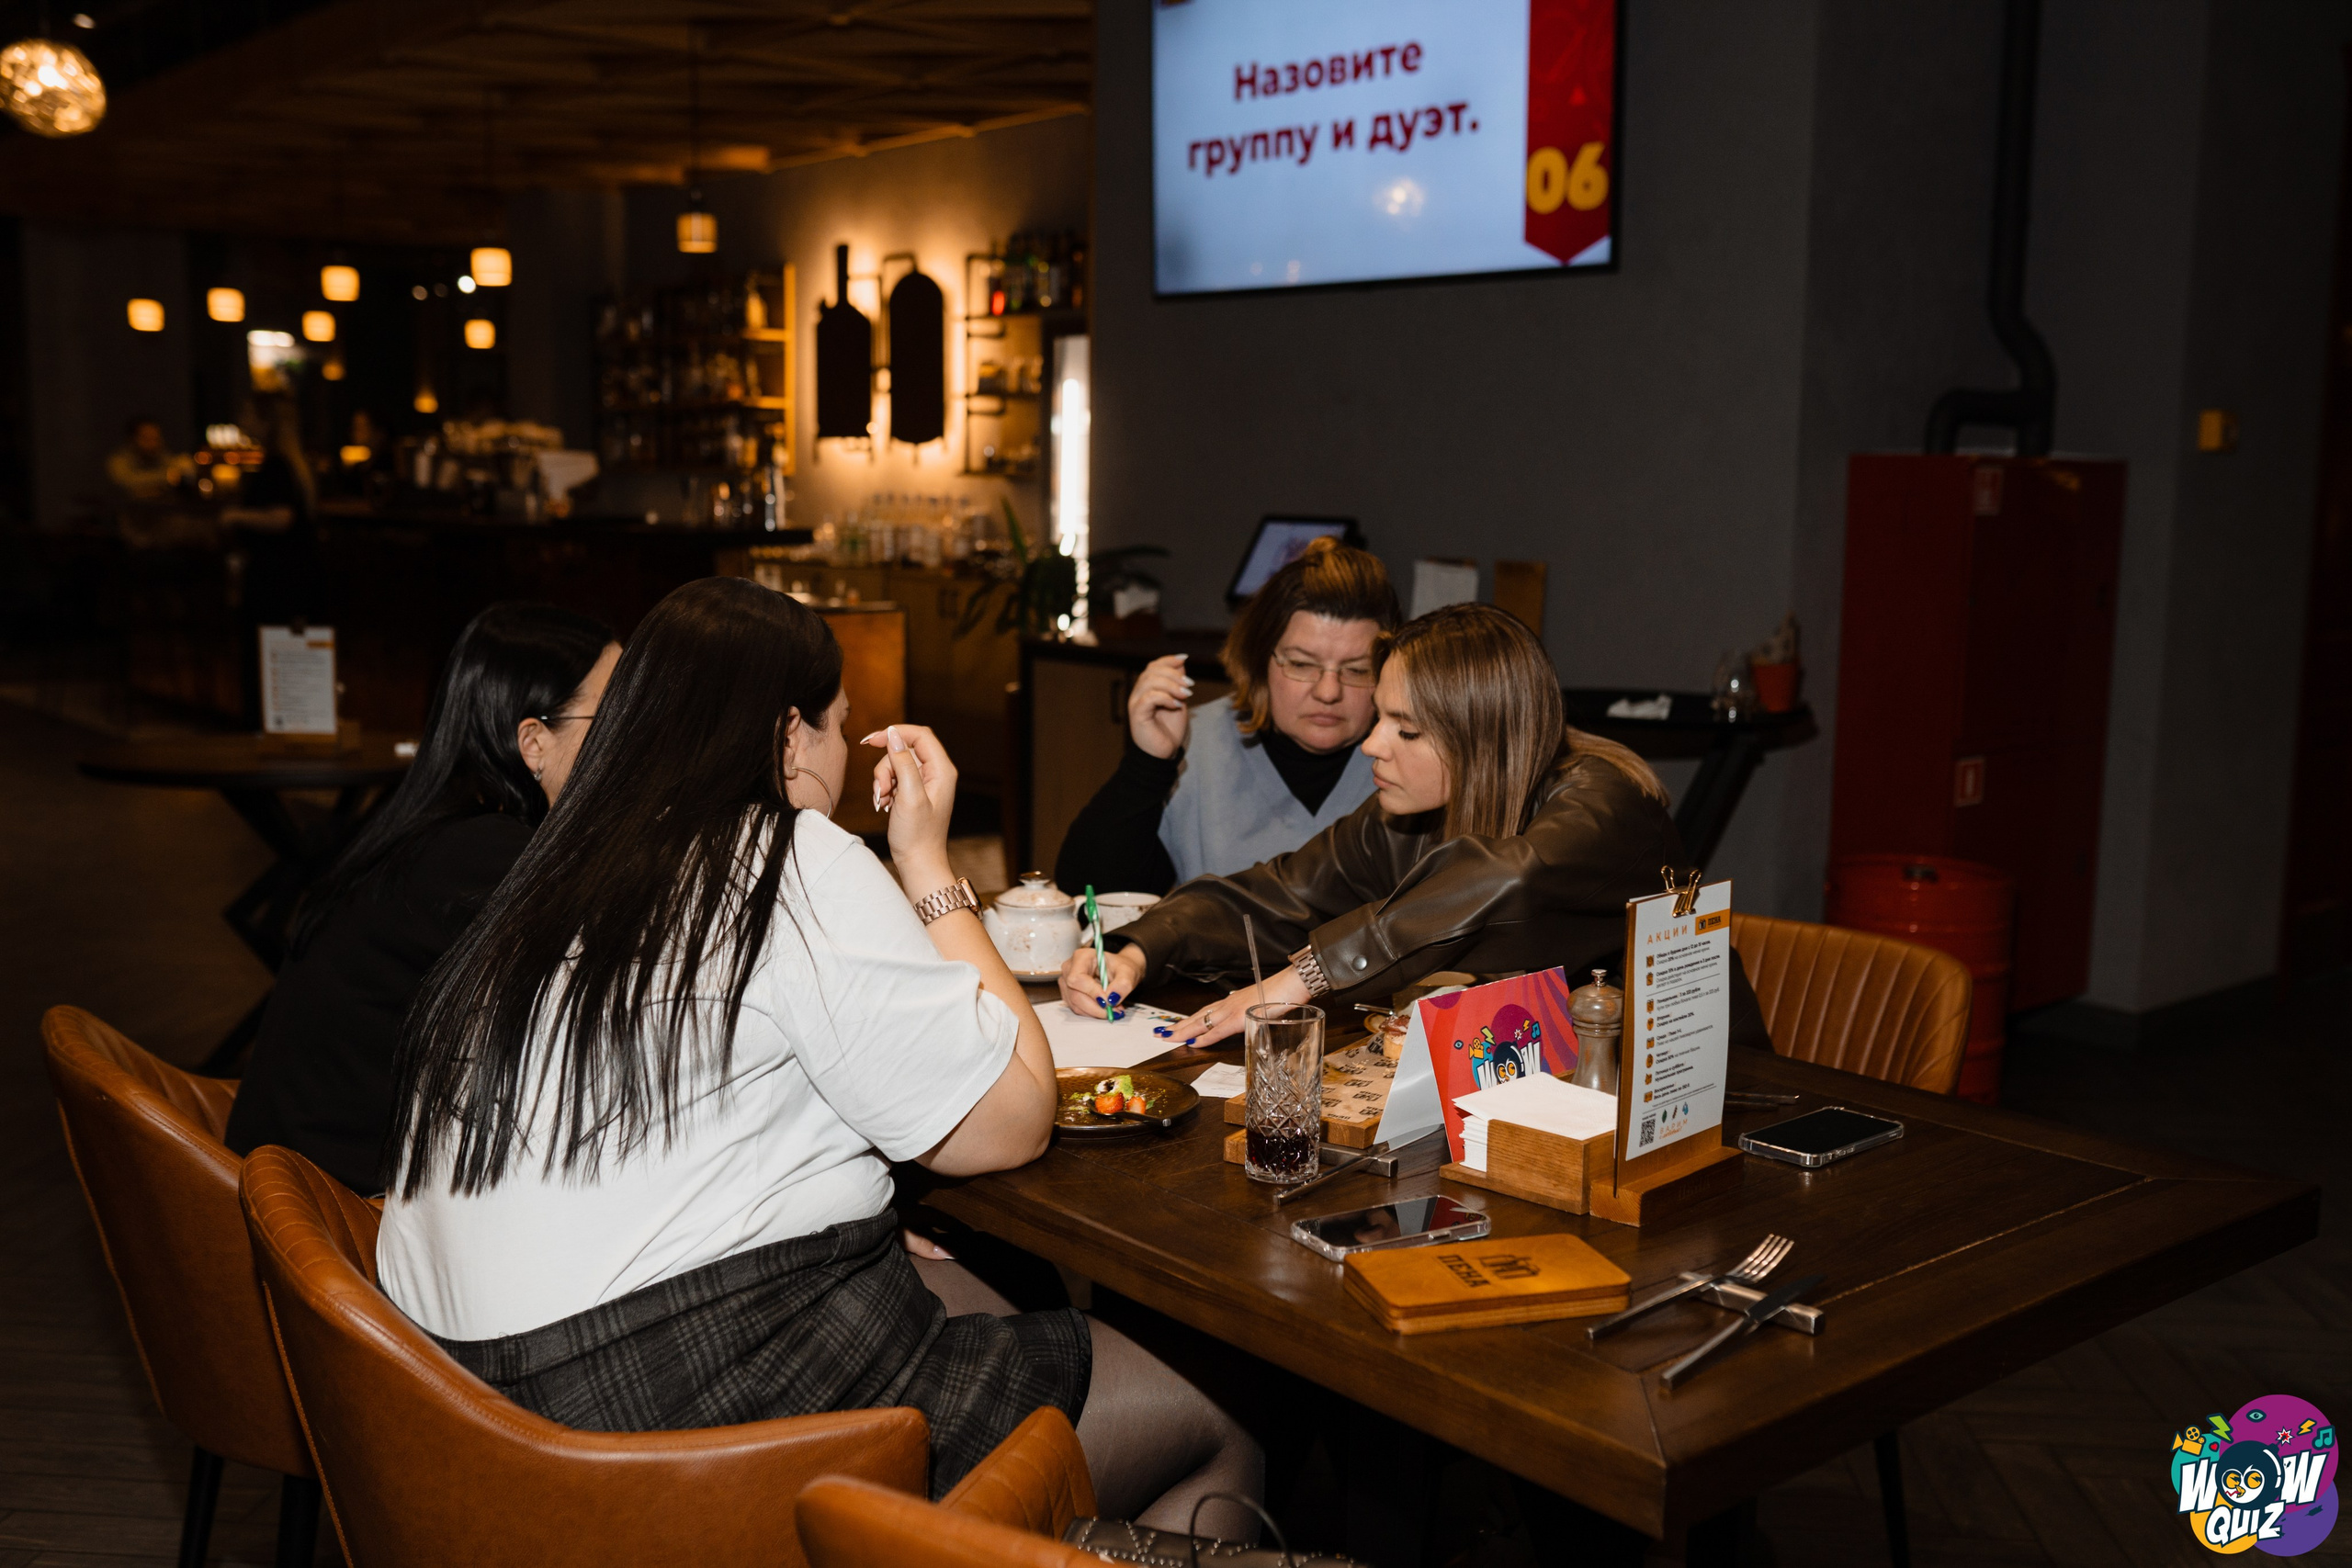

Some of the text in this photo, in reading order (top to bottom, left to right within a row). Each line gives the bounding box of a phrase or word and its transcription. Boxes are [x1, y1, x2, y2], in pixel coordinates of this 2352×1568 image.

[1233, 39, 1423, 102] Назовите
[1186, 100, 1481, 178] группу и дуэт.
[1526, 141, 1610, 215] 06
[1646, 925, 1688, 944] АКЦИИ
[1708, 916, 1722, 926] ПЕНА
[1659, 1119, 1688, 1134] ВАРИМ
[1437, 1255, 1493, 1288] ПЕНА
